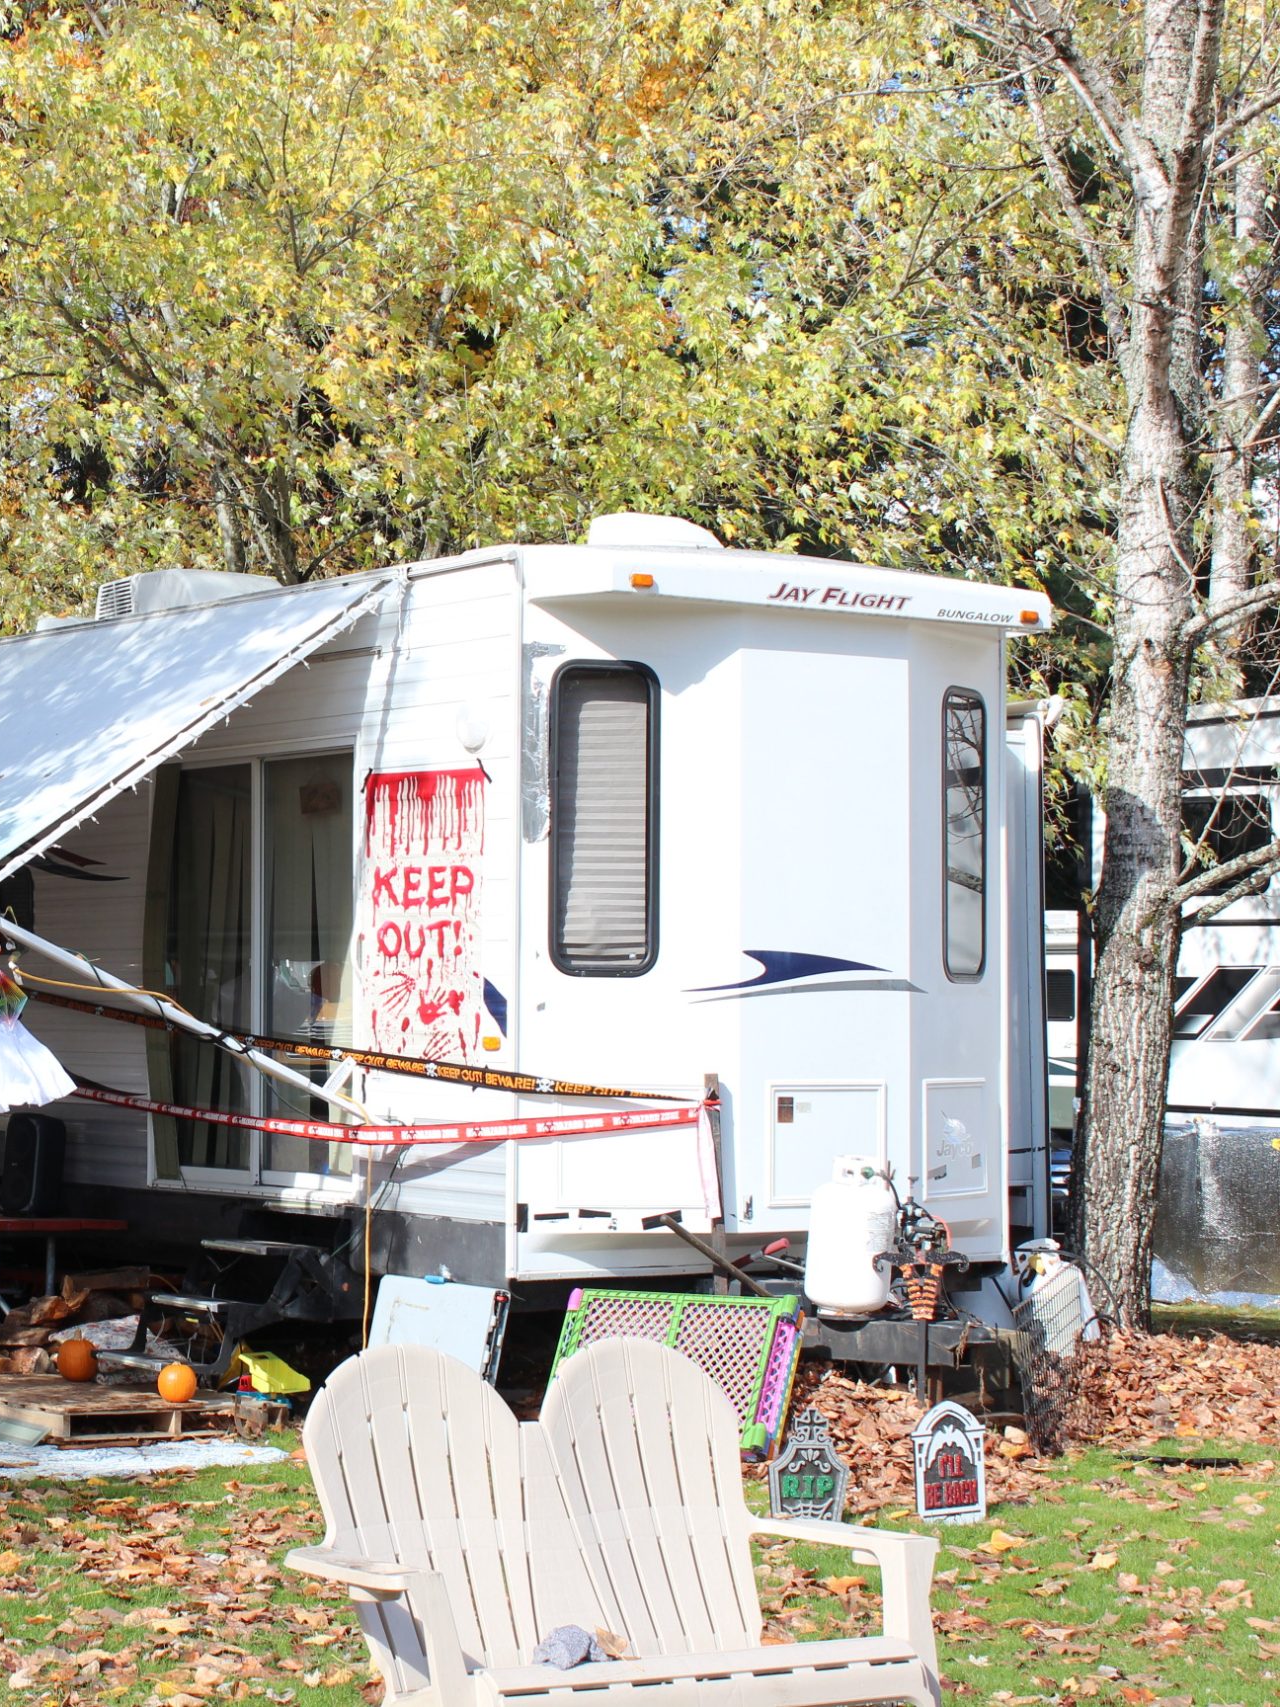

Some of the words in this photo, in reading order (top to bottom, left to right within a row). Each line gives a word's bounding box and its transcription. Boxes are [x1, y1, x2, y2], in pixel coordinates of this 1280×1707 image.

[768, 583, 817, 603] JAY
[821, 587, 911, 610] FLIGHT
[937, 609, 1013, 623] BUNGALOW
[371, 866, 475, 922] KEEP
[377, 920, 462, 974] OUT!
[386, 1059, 424, 1071] BEWARE!
[437, 1066, 460, 1079] KEEP
[461, 1069, 483, 1083] OUT!
[485, 1072, 536, 1090] BEWARE!
[554, 1081, 591, 1095] KEEP
[936, 1139, 972, 1160] Jayco
[782, 1474, 835, 1500] RIP
[925, 1484, 942, 1509] BE
[943, 1480, 979, 1507] BACK
